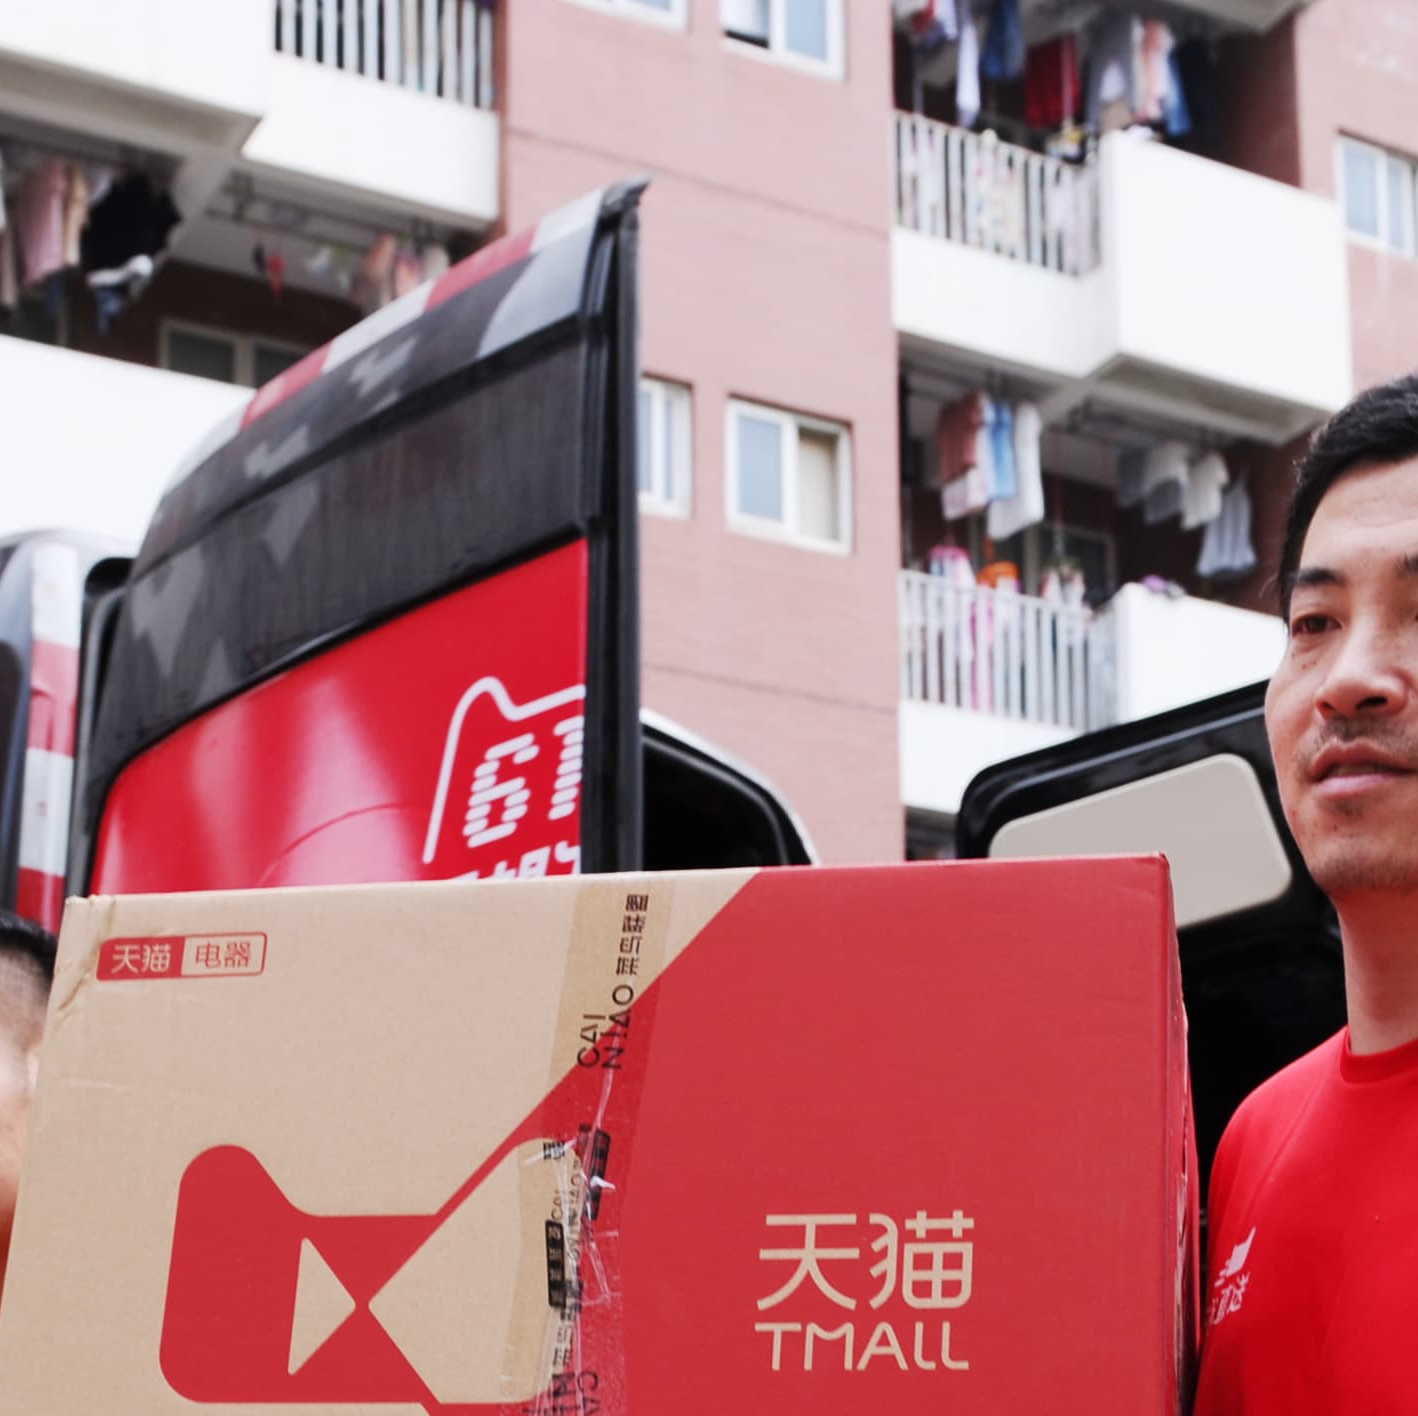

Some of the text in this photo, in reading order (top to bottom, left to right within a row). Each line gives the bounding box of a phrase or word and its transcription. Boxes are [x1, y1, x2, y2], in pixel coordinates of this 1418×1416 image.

[111, 943, 172, 974] 天猫
[195, 940, 252, 969] 电器
[577, 1013, 607, 1069] CAI
[756, 1209, 975, 1311] 天猫
[754, 1321, 970, 1371] TMALL
